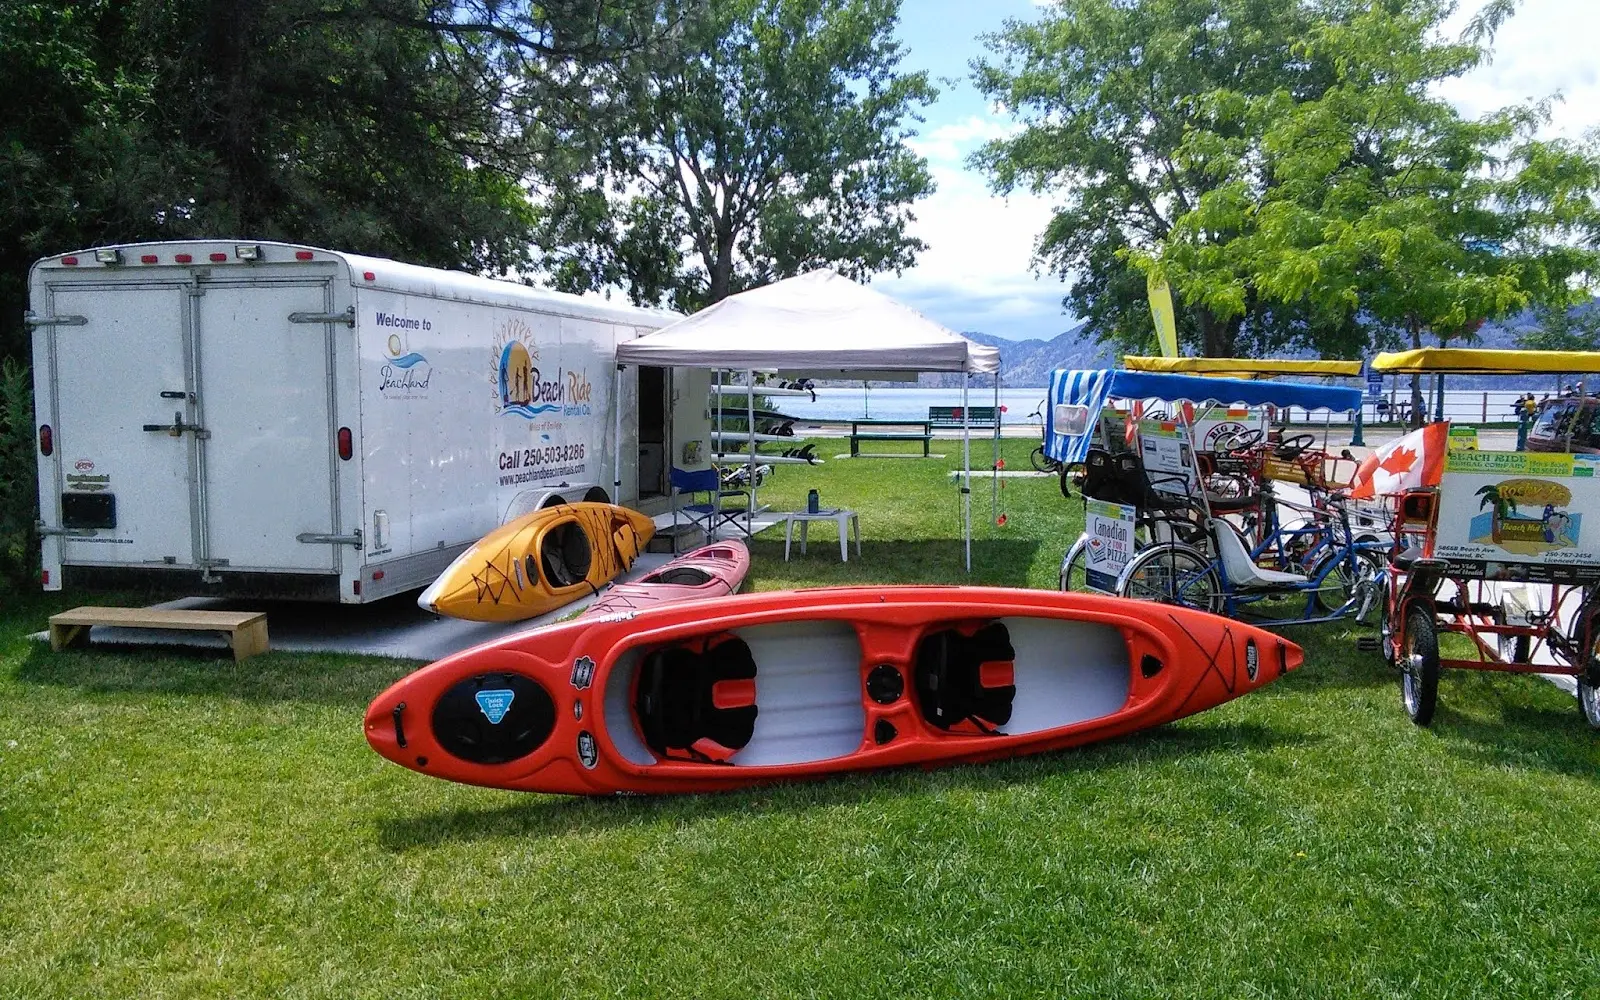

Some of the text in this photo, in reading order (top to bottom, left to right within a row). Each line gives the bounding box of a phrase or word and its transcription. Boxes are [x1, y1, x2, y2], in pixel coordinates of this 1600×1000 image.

[376, 312, 432, 331] Welcome to
[379, 365, 433, 392] Peachland
[531, 367, 592, 403] Beach Ride
[563, 404, 581, 417] Rental
[1209, 424, 1228, 440] BIG
[499, 443, 585, 470] Call 250-503-8286
[1450, 452, 1528, 463] BEACH RIDE
[499, 464, 585, 488] www.peachlandbeachrentals.com
[1094, 516, 1128, 541] Canadian
[1502, 522, 1526, 533] Beach
[1106, 540, 1112, 548] 2
[1437, 551, 1473, 559] Peachland,
